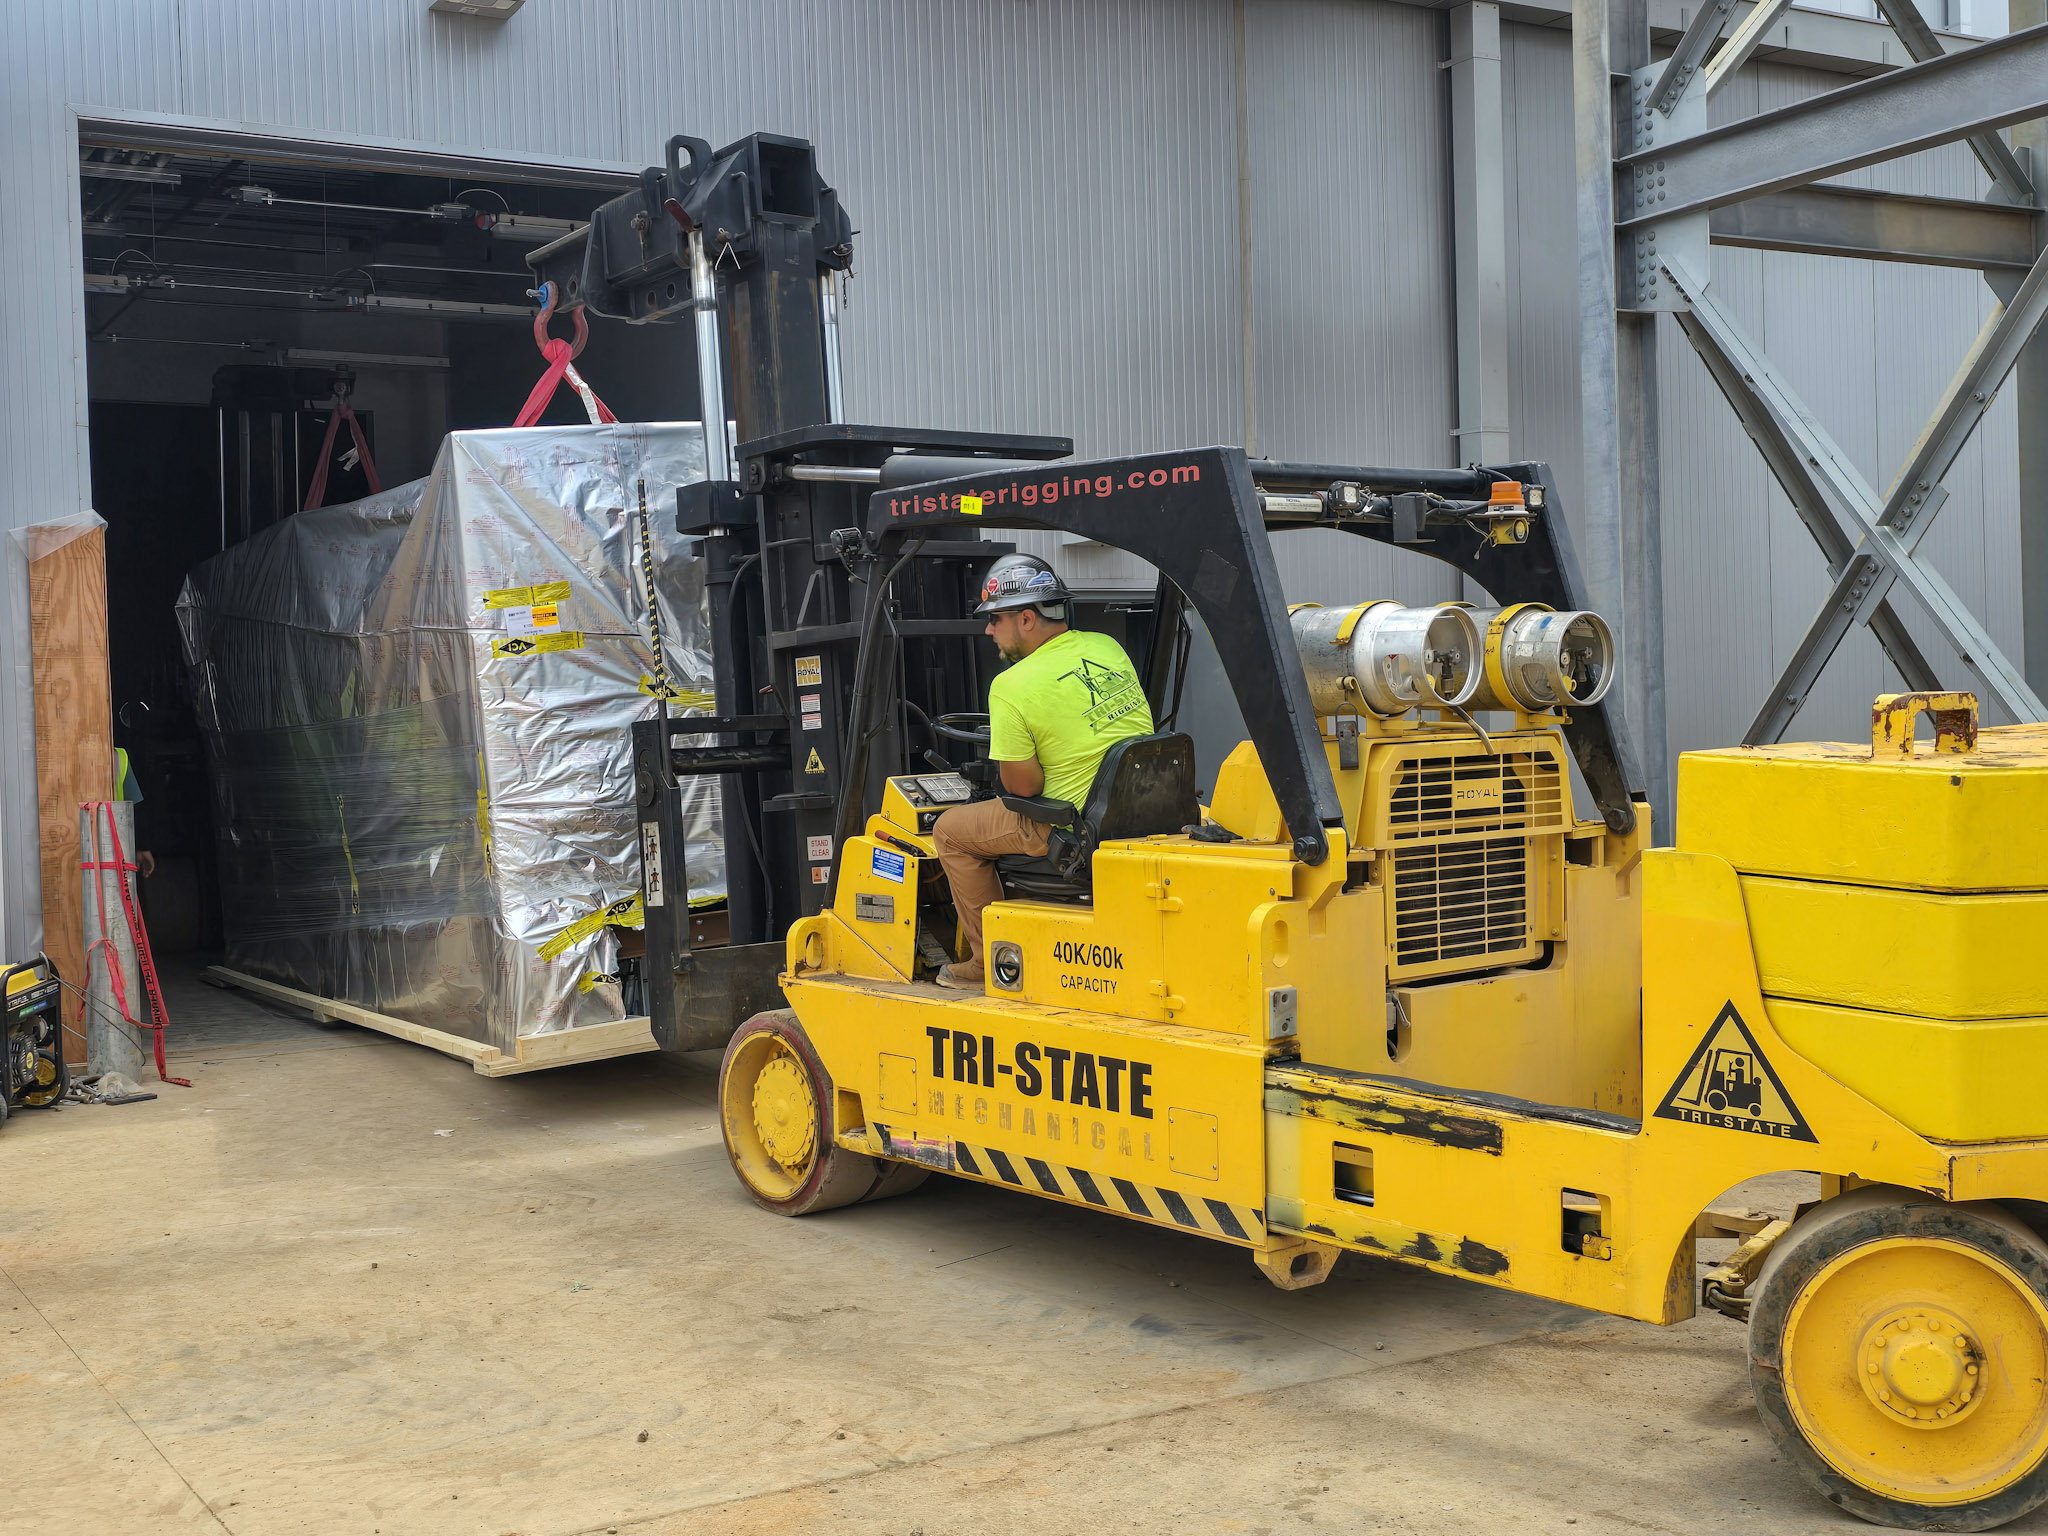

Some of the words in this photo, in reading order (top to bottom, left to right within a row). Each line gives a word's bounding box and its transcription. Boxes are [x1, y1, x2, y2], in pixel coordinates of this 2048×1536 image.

[508, 642, 527, 652] VCI
[797, 668, 820, 676] ROYAL
[1457, 788, 1499, 799] ROYAL
[811, 839, 829, 847] STAND
[811, 848, 830, 857] CLEAR
[611, 902, 629, 914] VCI
[1053, 941, 1124, 970] 40K/60k
[1060, 974, 1117, 994] CAPACITY
[926, 1026, 1154, 1119] TRI-STATE
[928, 1088, 1155, 1162] MECHANICAL
[1678, 1108, 1792, 1138] TRI-STATE
